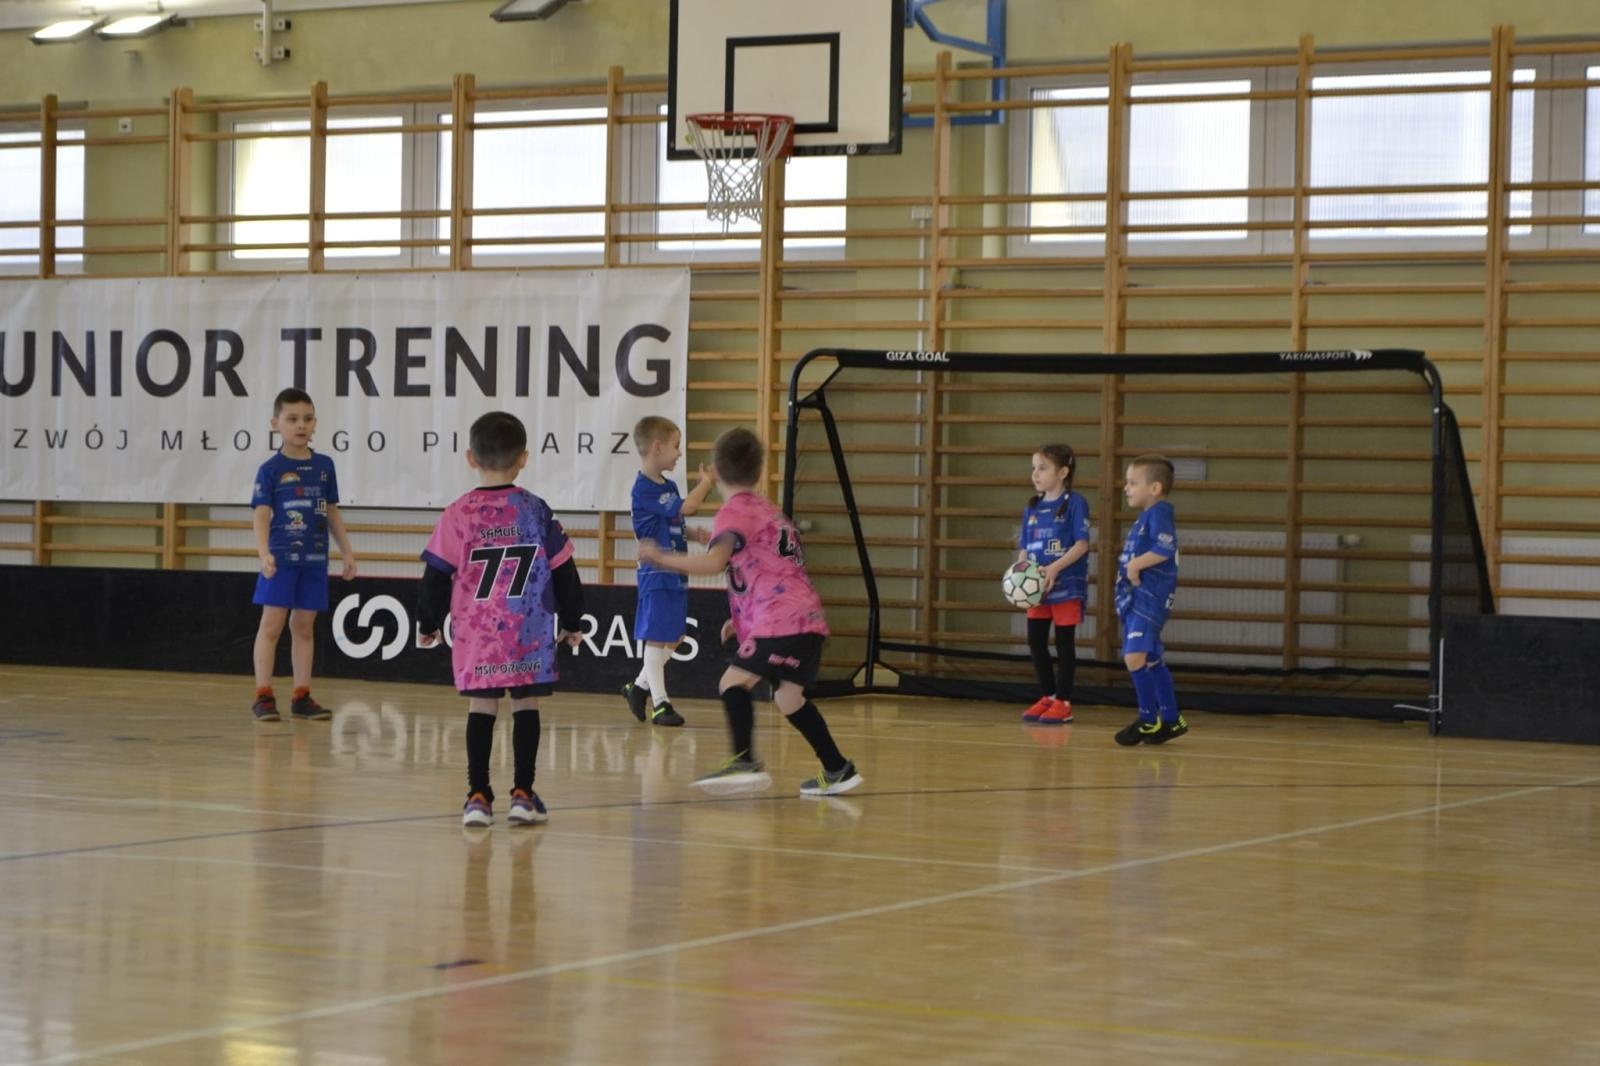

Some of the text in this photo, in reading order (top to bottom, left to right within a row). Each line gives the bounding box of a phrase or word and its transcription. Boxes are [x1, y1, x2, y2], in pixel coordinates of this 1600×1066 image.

[281, 323, 672, 398] TRENING
[886, 351, 950, 362] GIZA GOAL
[13, 424, 128, 450] ZWÓJ
[161, 429, 386, 452] MŁODGO
[480, 526, 522, 539] SAMUEL
[469, 544, 540, 601] 77
